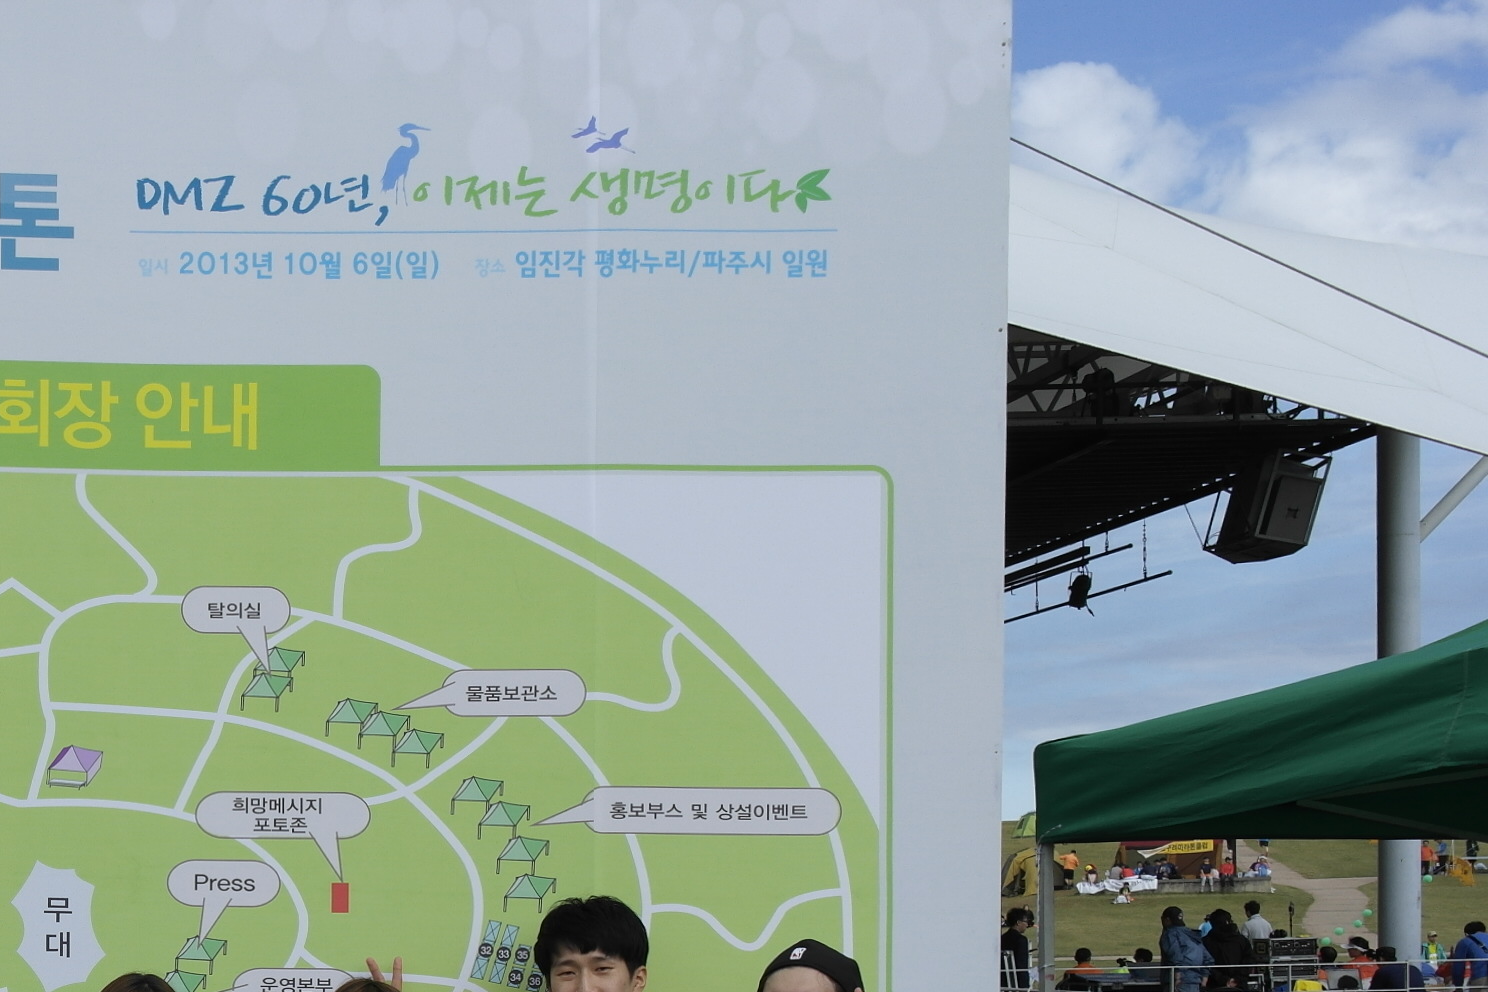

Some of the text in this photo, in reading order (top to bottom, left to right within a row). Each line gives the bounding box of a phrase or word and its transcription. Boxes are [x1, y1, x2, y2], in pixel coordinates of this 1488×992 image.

[136, 166, 798, 227] DMZ 60년, 이제는 생명이다
[138, 248, 827, 280] 일시 2013년 10월 6일(일) 장소 임진각 평화누리/파주시 일원
[134, 382, 259, 451] 안내
[207, 601, 262, 621] 탈의실
[465, 684, 558, 703] 물품보관소
[231, 797, 323, 816] 희망메시지
[609, 802, 808, 822] 홍보부스 및 상설이벤트
[253, 816, 308, 835] 포토존
[193, 873, 256, 893] Press
[481, 947, 492, 955] 32
[498, 950, 510, 959] 33
[517, 950, 528, 959] 35
[510, 973, 521, 982] 34
[528, 977, 541, 986] 36
